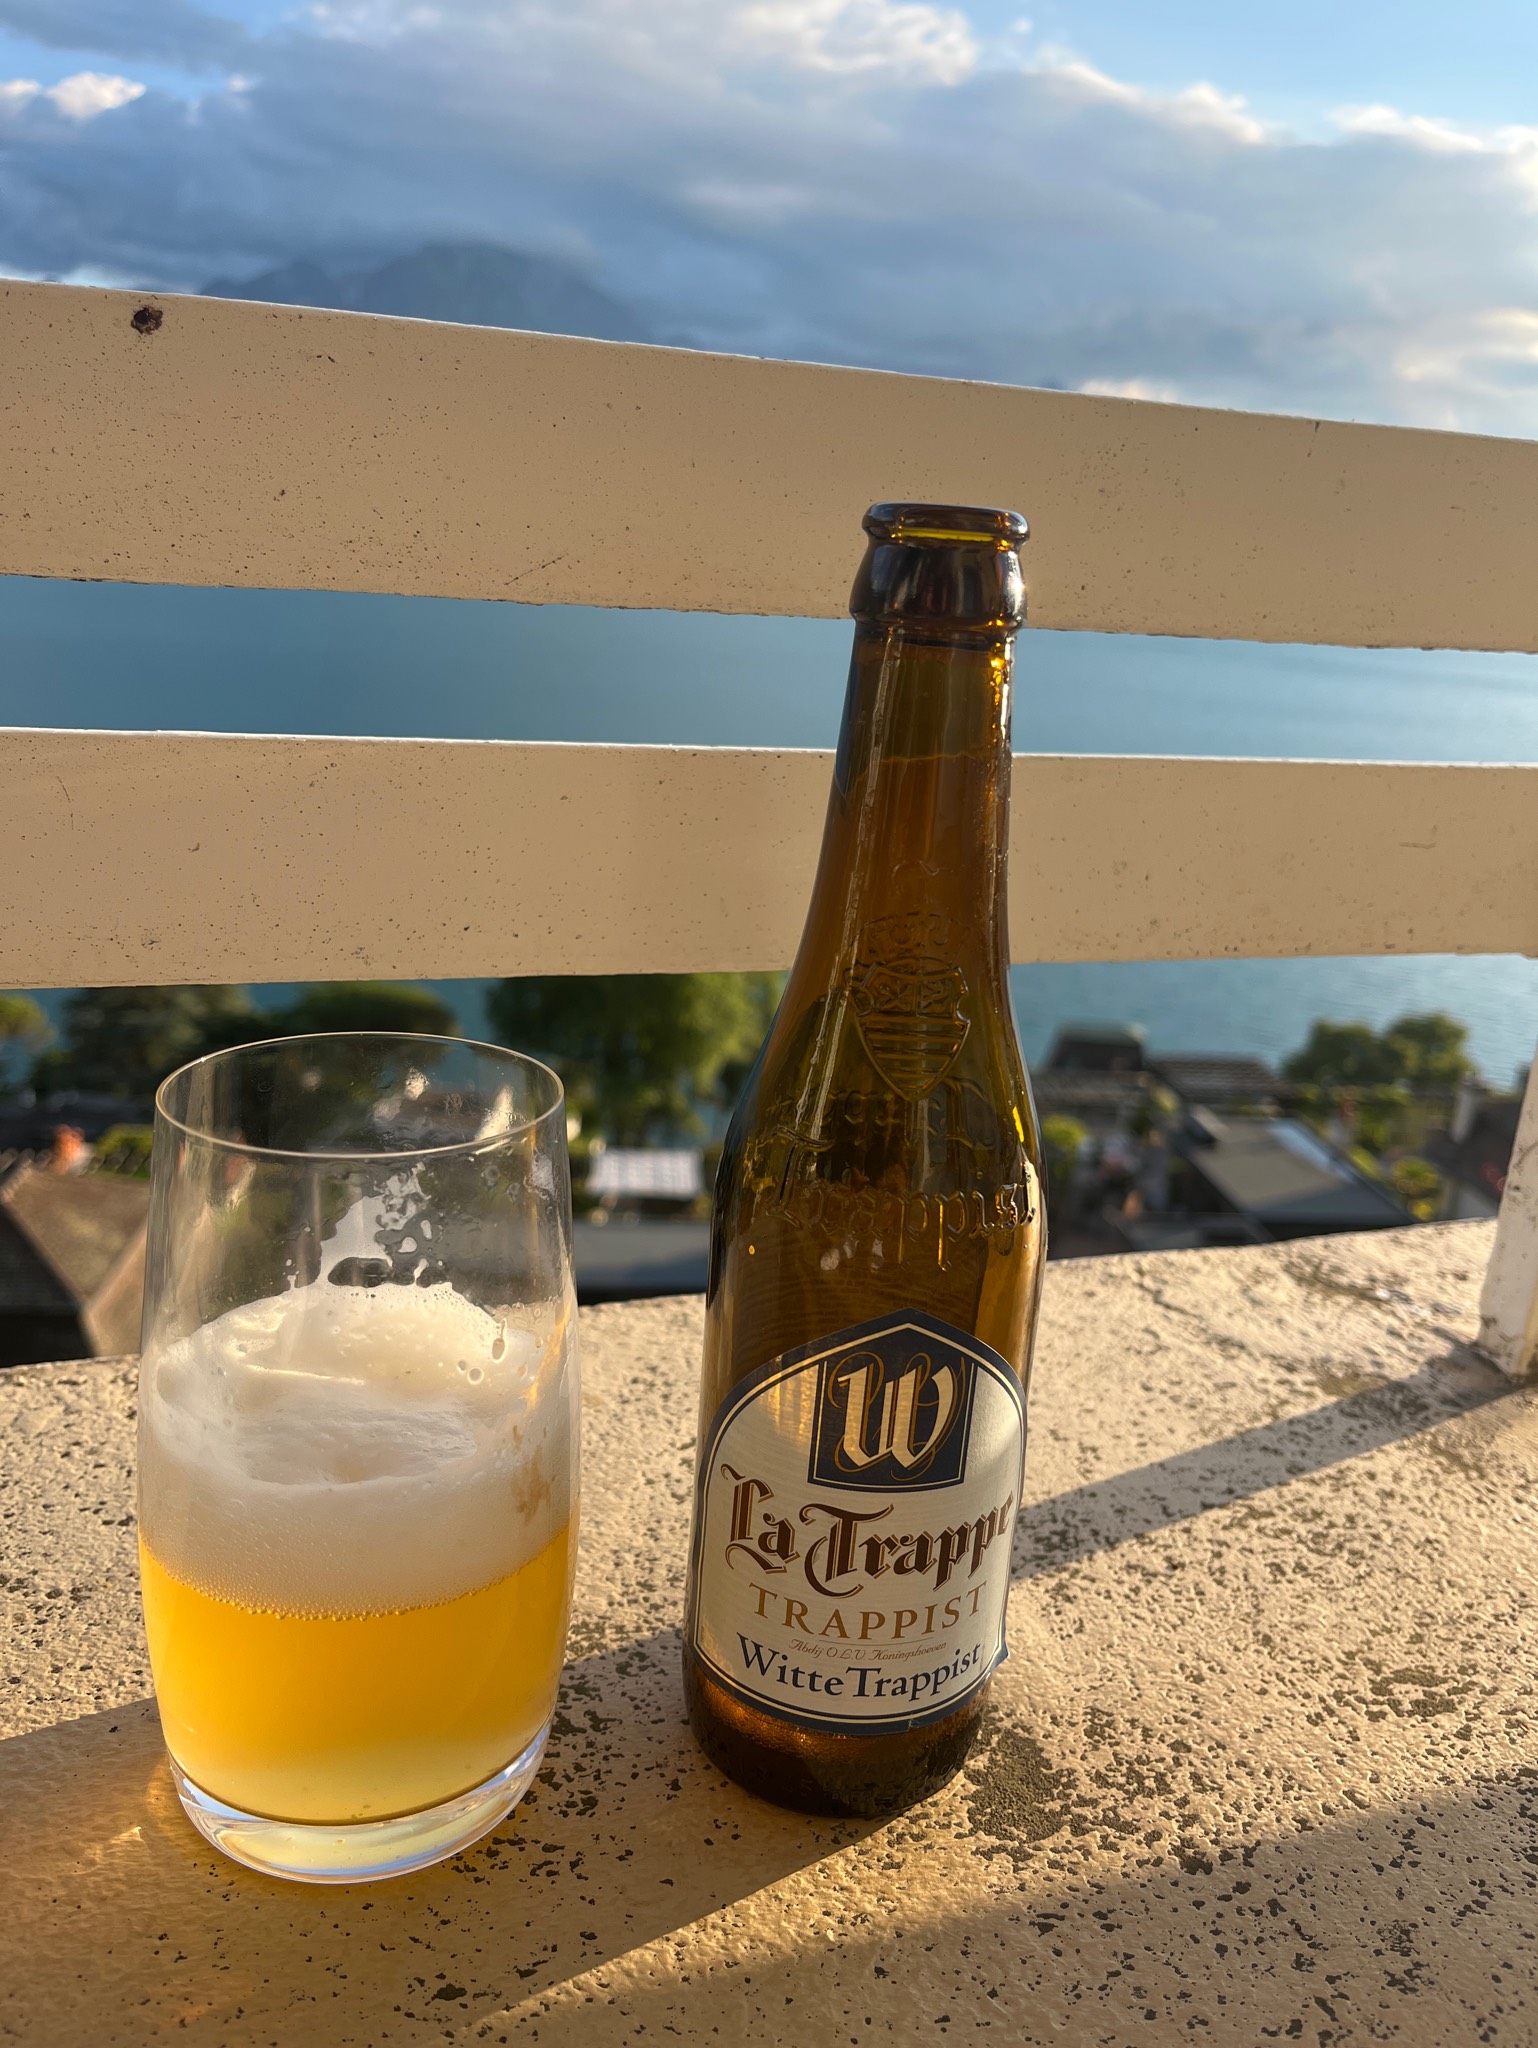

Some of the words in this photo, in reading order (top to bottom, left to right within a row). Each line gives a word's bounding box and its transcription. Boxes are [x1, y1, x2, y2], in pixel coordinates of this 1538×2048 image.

[833, 1359, 962, 1475] W
[720, 1463, 801, 1575] La
[799, 1490, 1014, 1599] Trappe
[749, 1581, 988, 1640] TRAPPIST
[736, 1632, 844, 1696] Witte
[846, 1643, 981, 1702] Trappist
